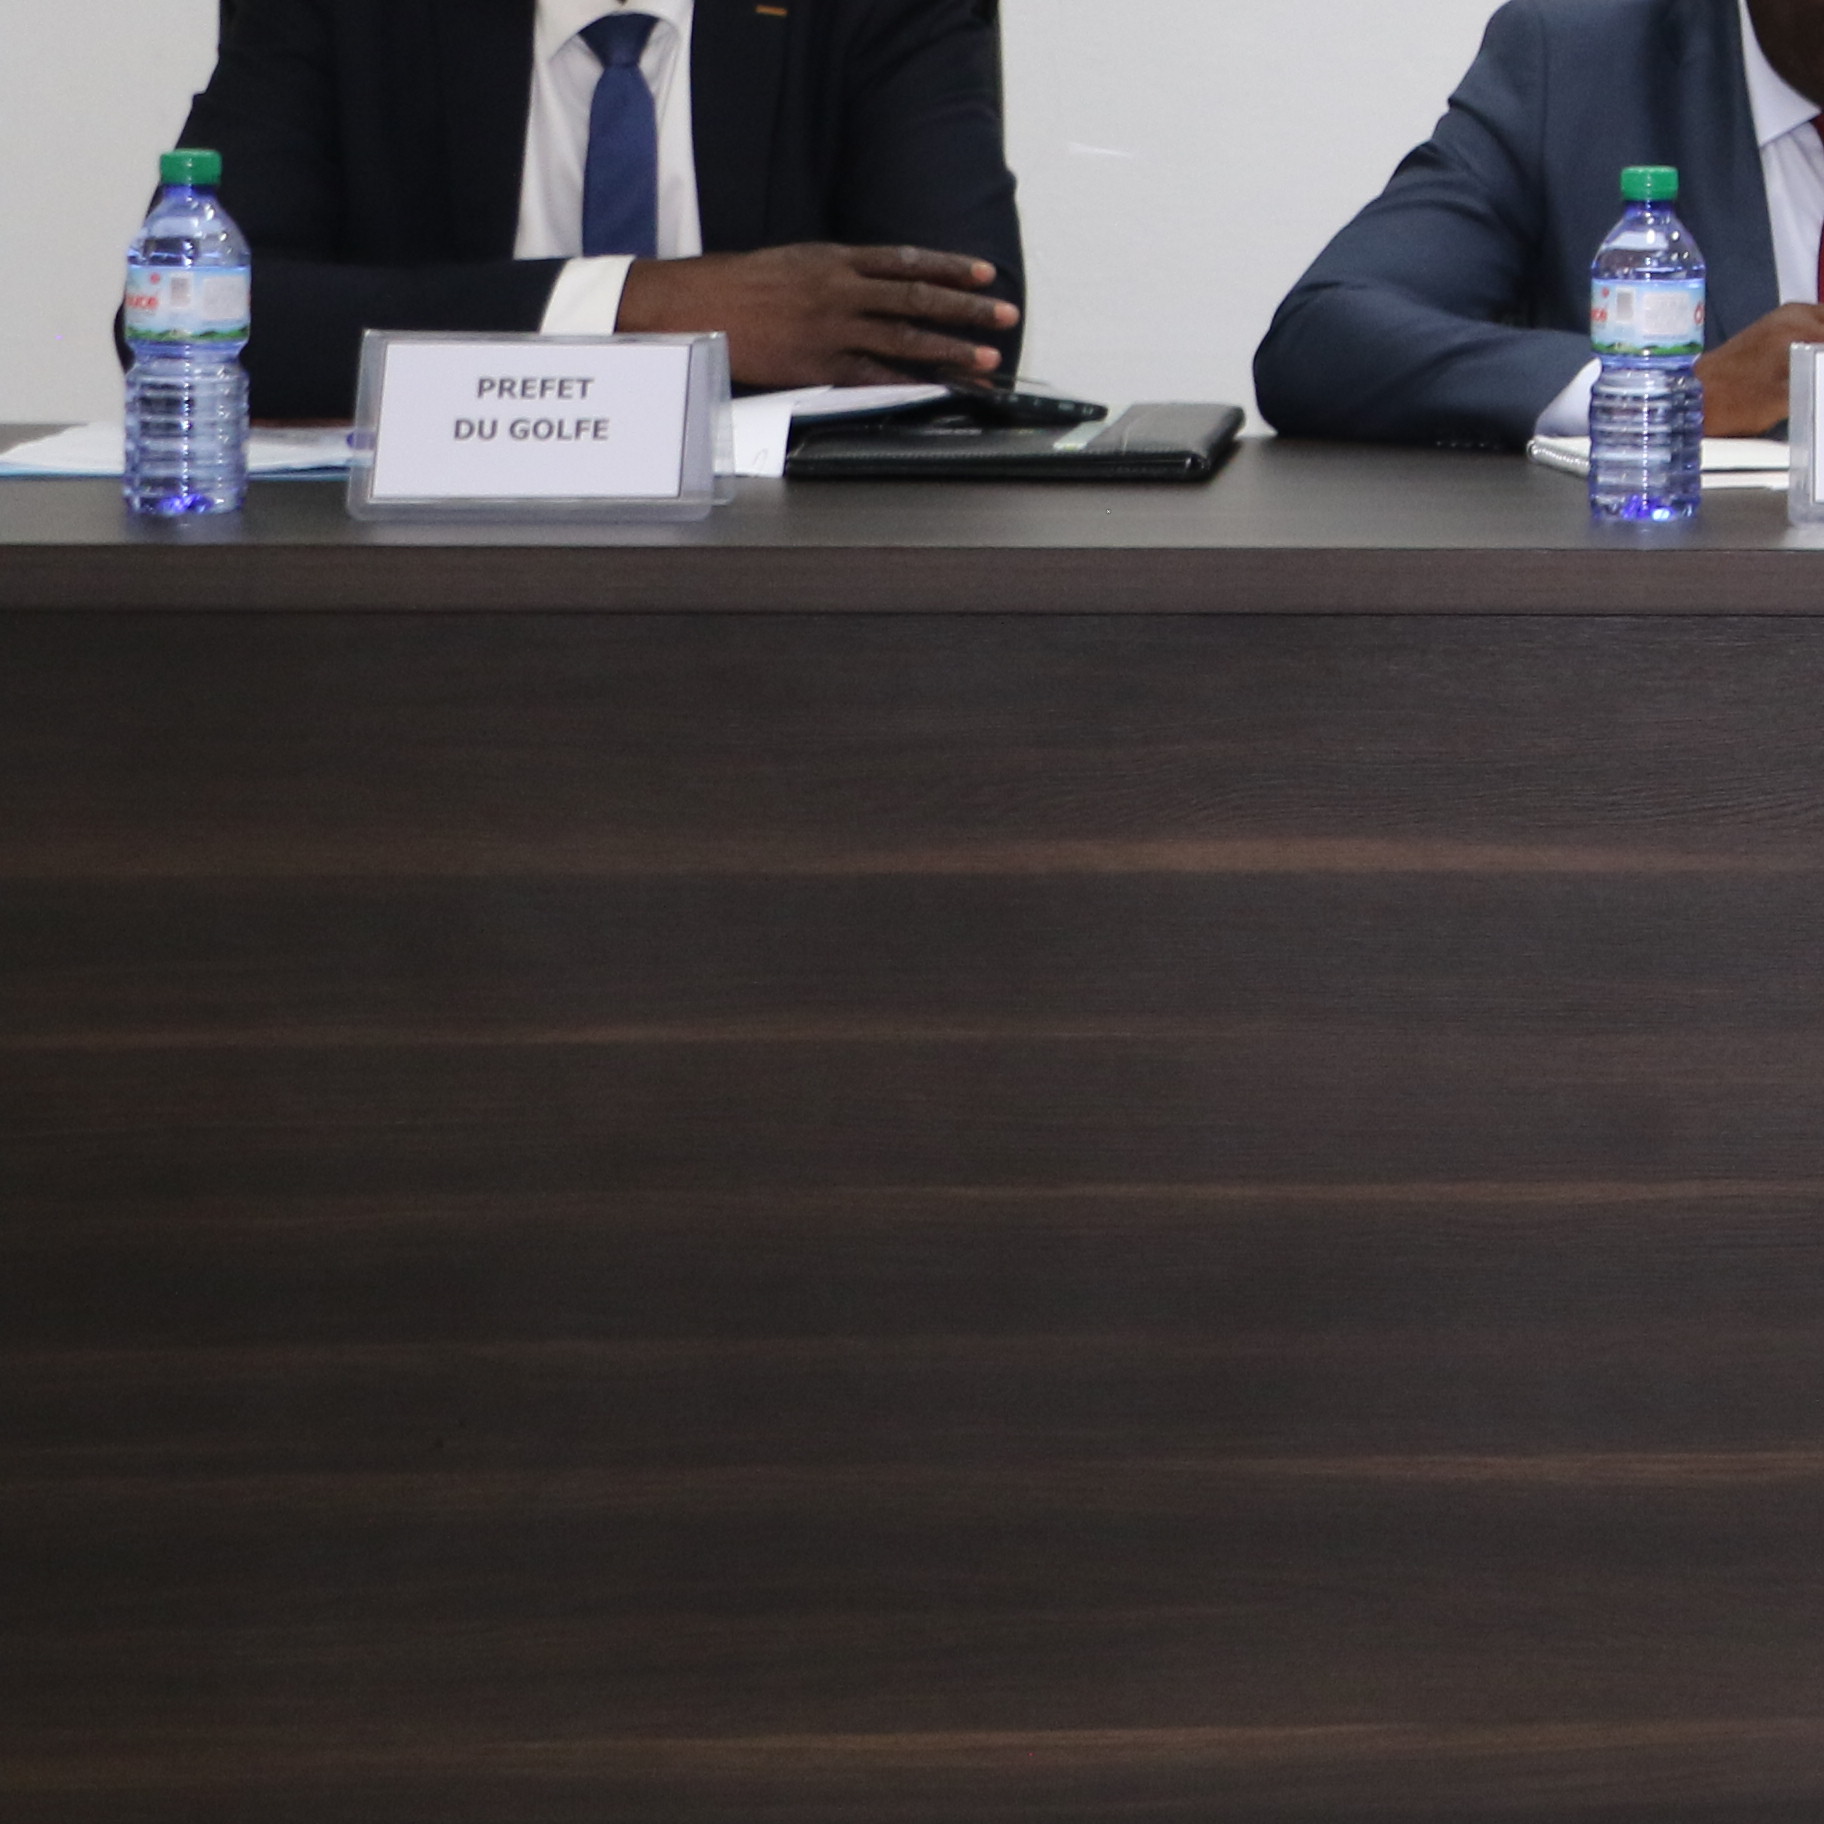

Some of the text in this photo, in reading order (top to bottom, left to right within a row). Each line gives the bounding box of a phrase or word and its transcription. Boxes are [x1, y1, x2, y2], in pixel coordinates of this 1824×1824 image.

[476, 376, 593, 399] PREFET
[453, 417, 611, 442] DU GOLFE
